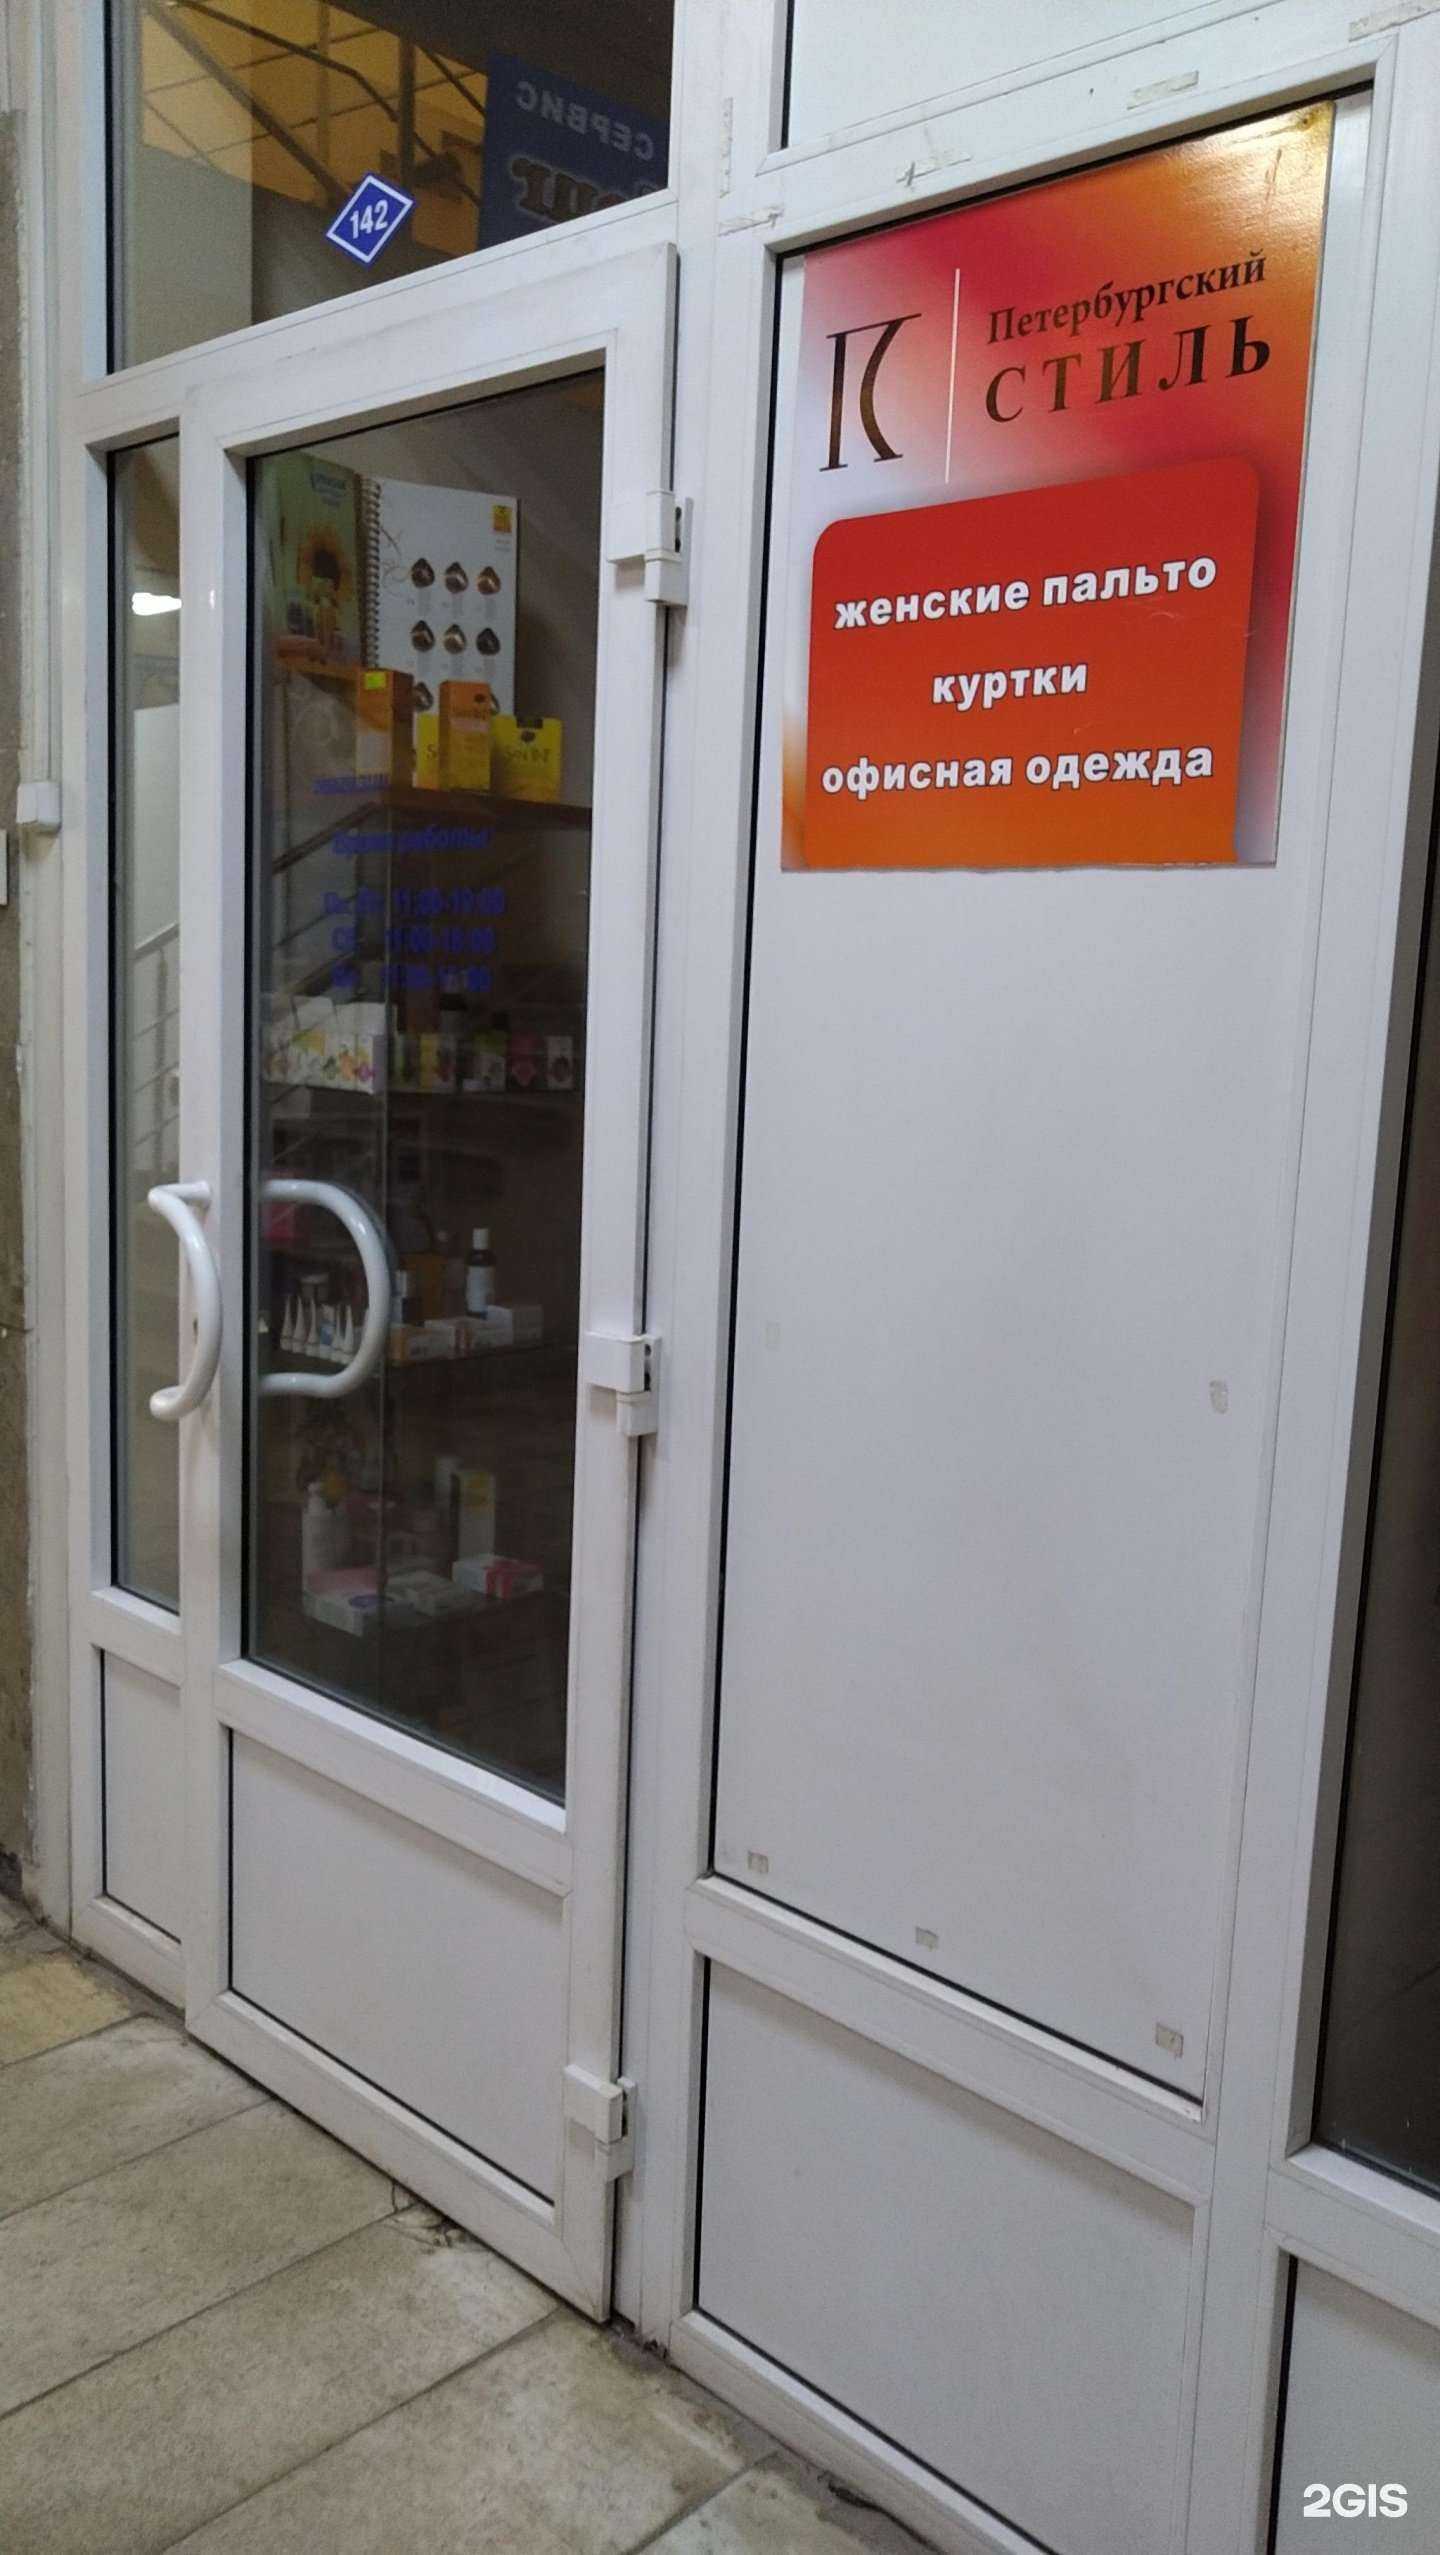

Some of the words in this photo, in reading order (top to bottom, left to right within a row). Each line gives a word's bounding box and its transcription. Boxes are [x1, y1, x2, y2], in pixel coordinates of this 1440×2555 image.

[350, 199, 389, 239] 142
[987, 248, 1267, 345] Петербургский
[985, 315, 1271, 424] СТИЛЬ
[833, 579, 1031, 630] женские
[1042, 556, 1218, 606] пальто
[932, 663, 1088, 712] куртки
[821, 756, 1013, 801] офисная
[1025, 745, 1214, 791] одежда
